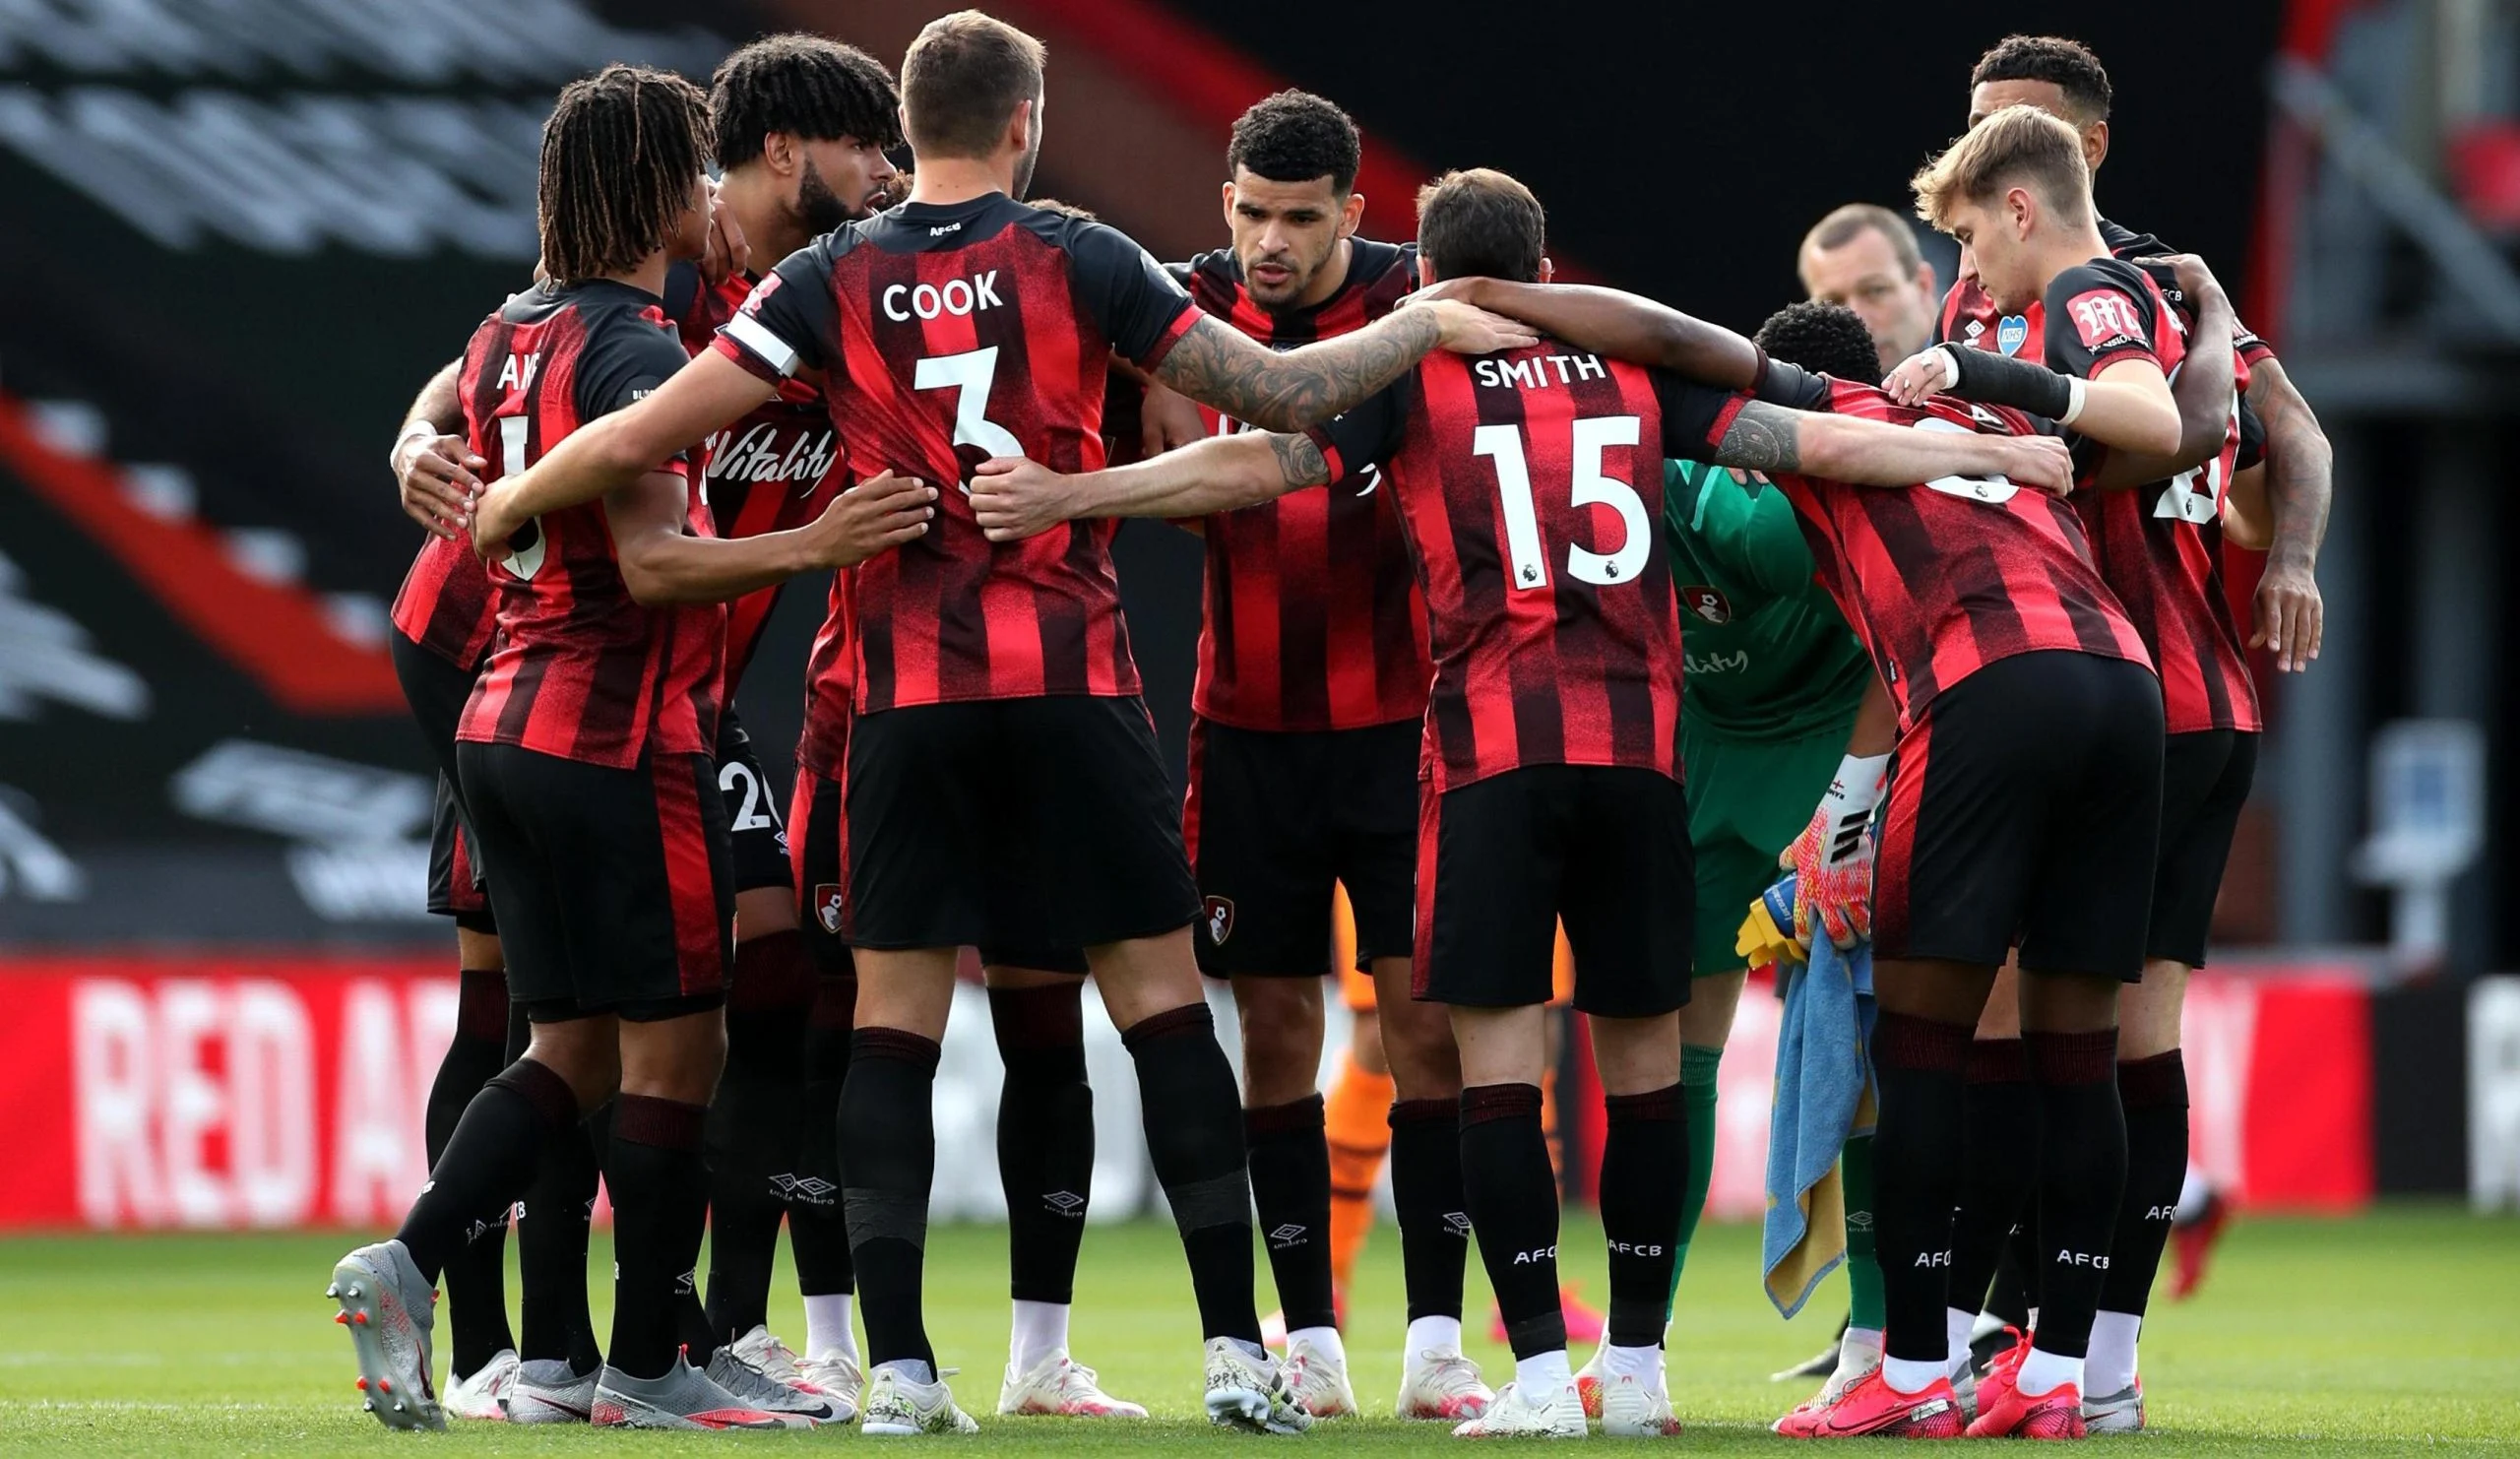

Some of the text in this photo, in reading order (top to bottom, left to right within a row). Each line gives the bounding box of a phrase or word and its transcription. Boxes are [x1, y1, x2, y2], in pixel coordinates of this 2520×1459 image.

[883, 270, 1003, 322] COOK
[1475, 354, 1606, 388] SMITH
[707, 422, 838, 499] Vitality
[1473, 415, 1652, 590] 15
[73, 975, 319, 1233] RED
[797, 1193, 835, 1205] umbro
[1608, 1238, 1663, 1257] AFCB
[2056, 1249, 2110, 1269] AFCB
